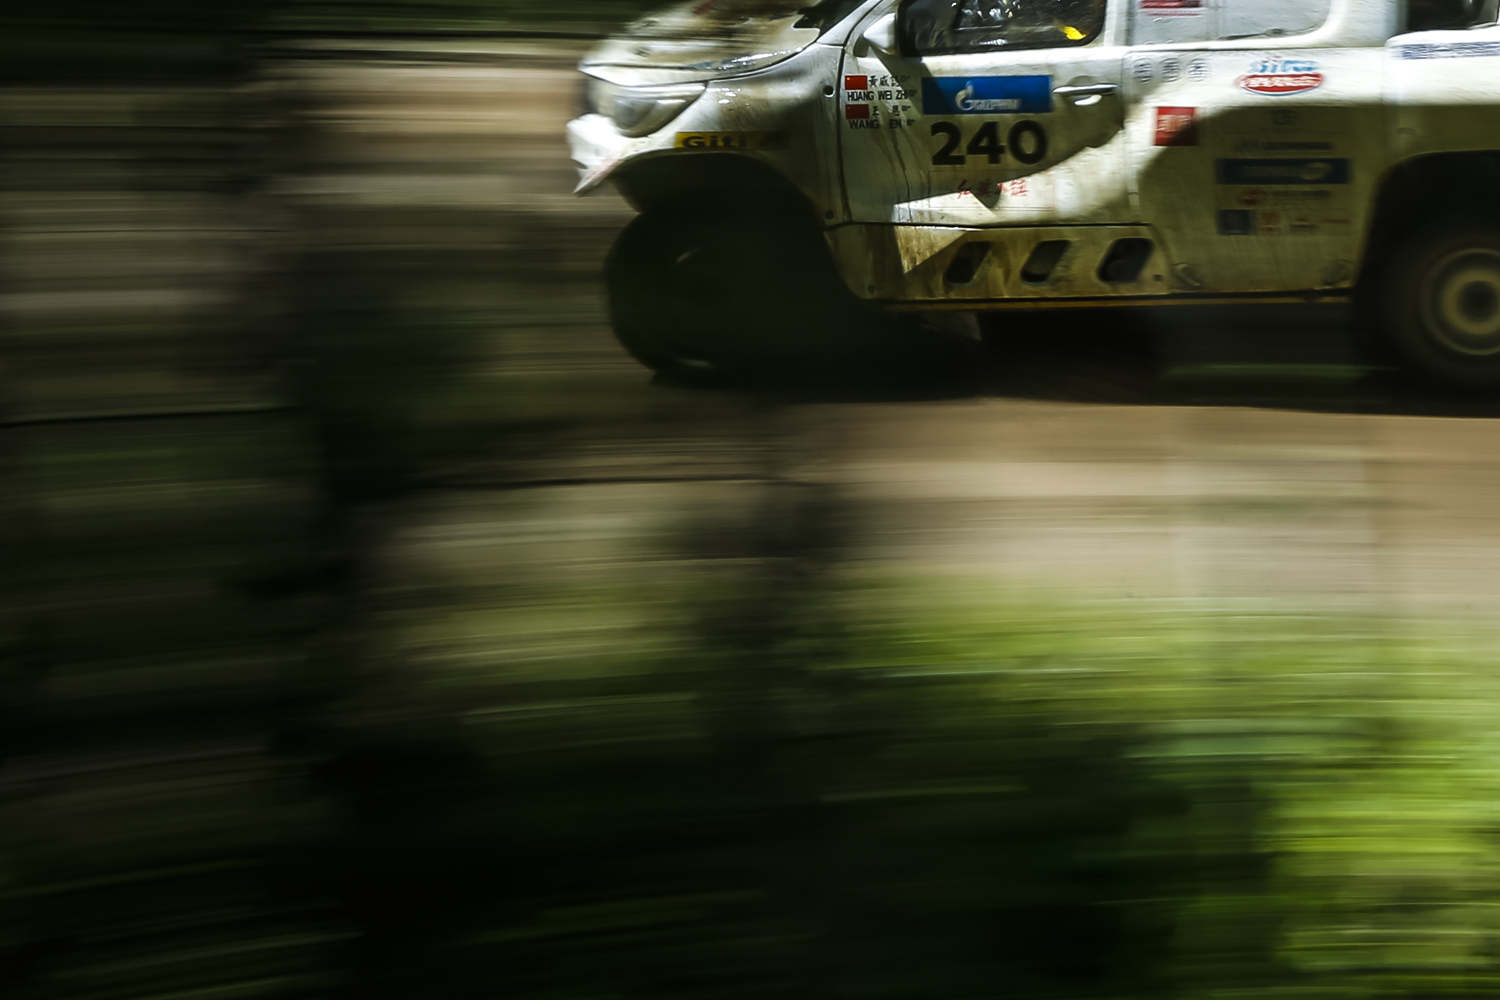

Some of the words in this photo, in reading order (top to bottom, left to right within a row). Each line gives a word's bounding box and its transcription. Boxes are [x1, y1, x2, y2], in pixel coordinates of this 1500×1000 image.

[847, 91, 874, 101] HUANG
[878, 90, 892, 100] WEI
[849, 119, 880, 129] WANG
[682, 135, 748, 149] Giti
[930, 120, 1048, 165] 240
